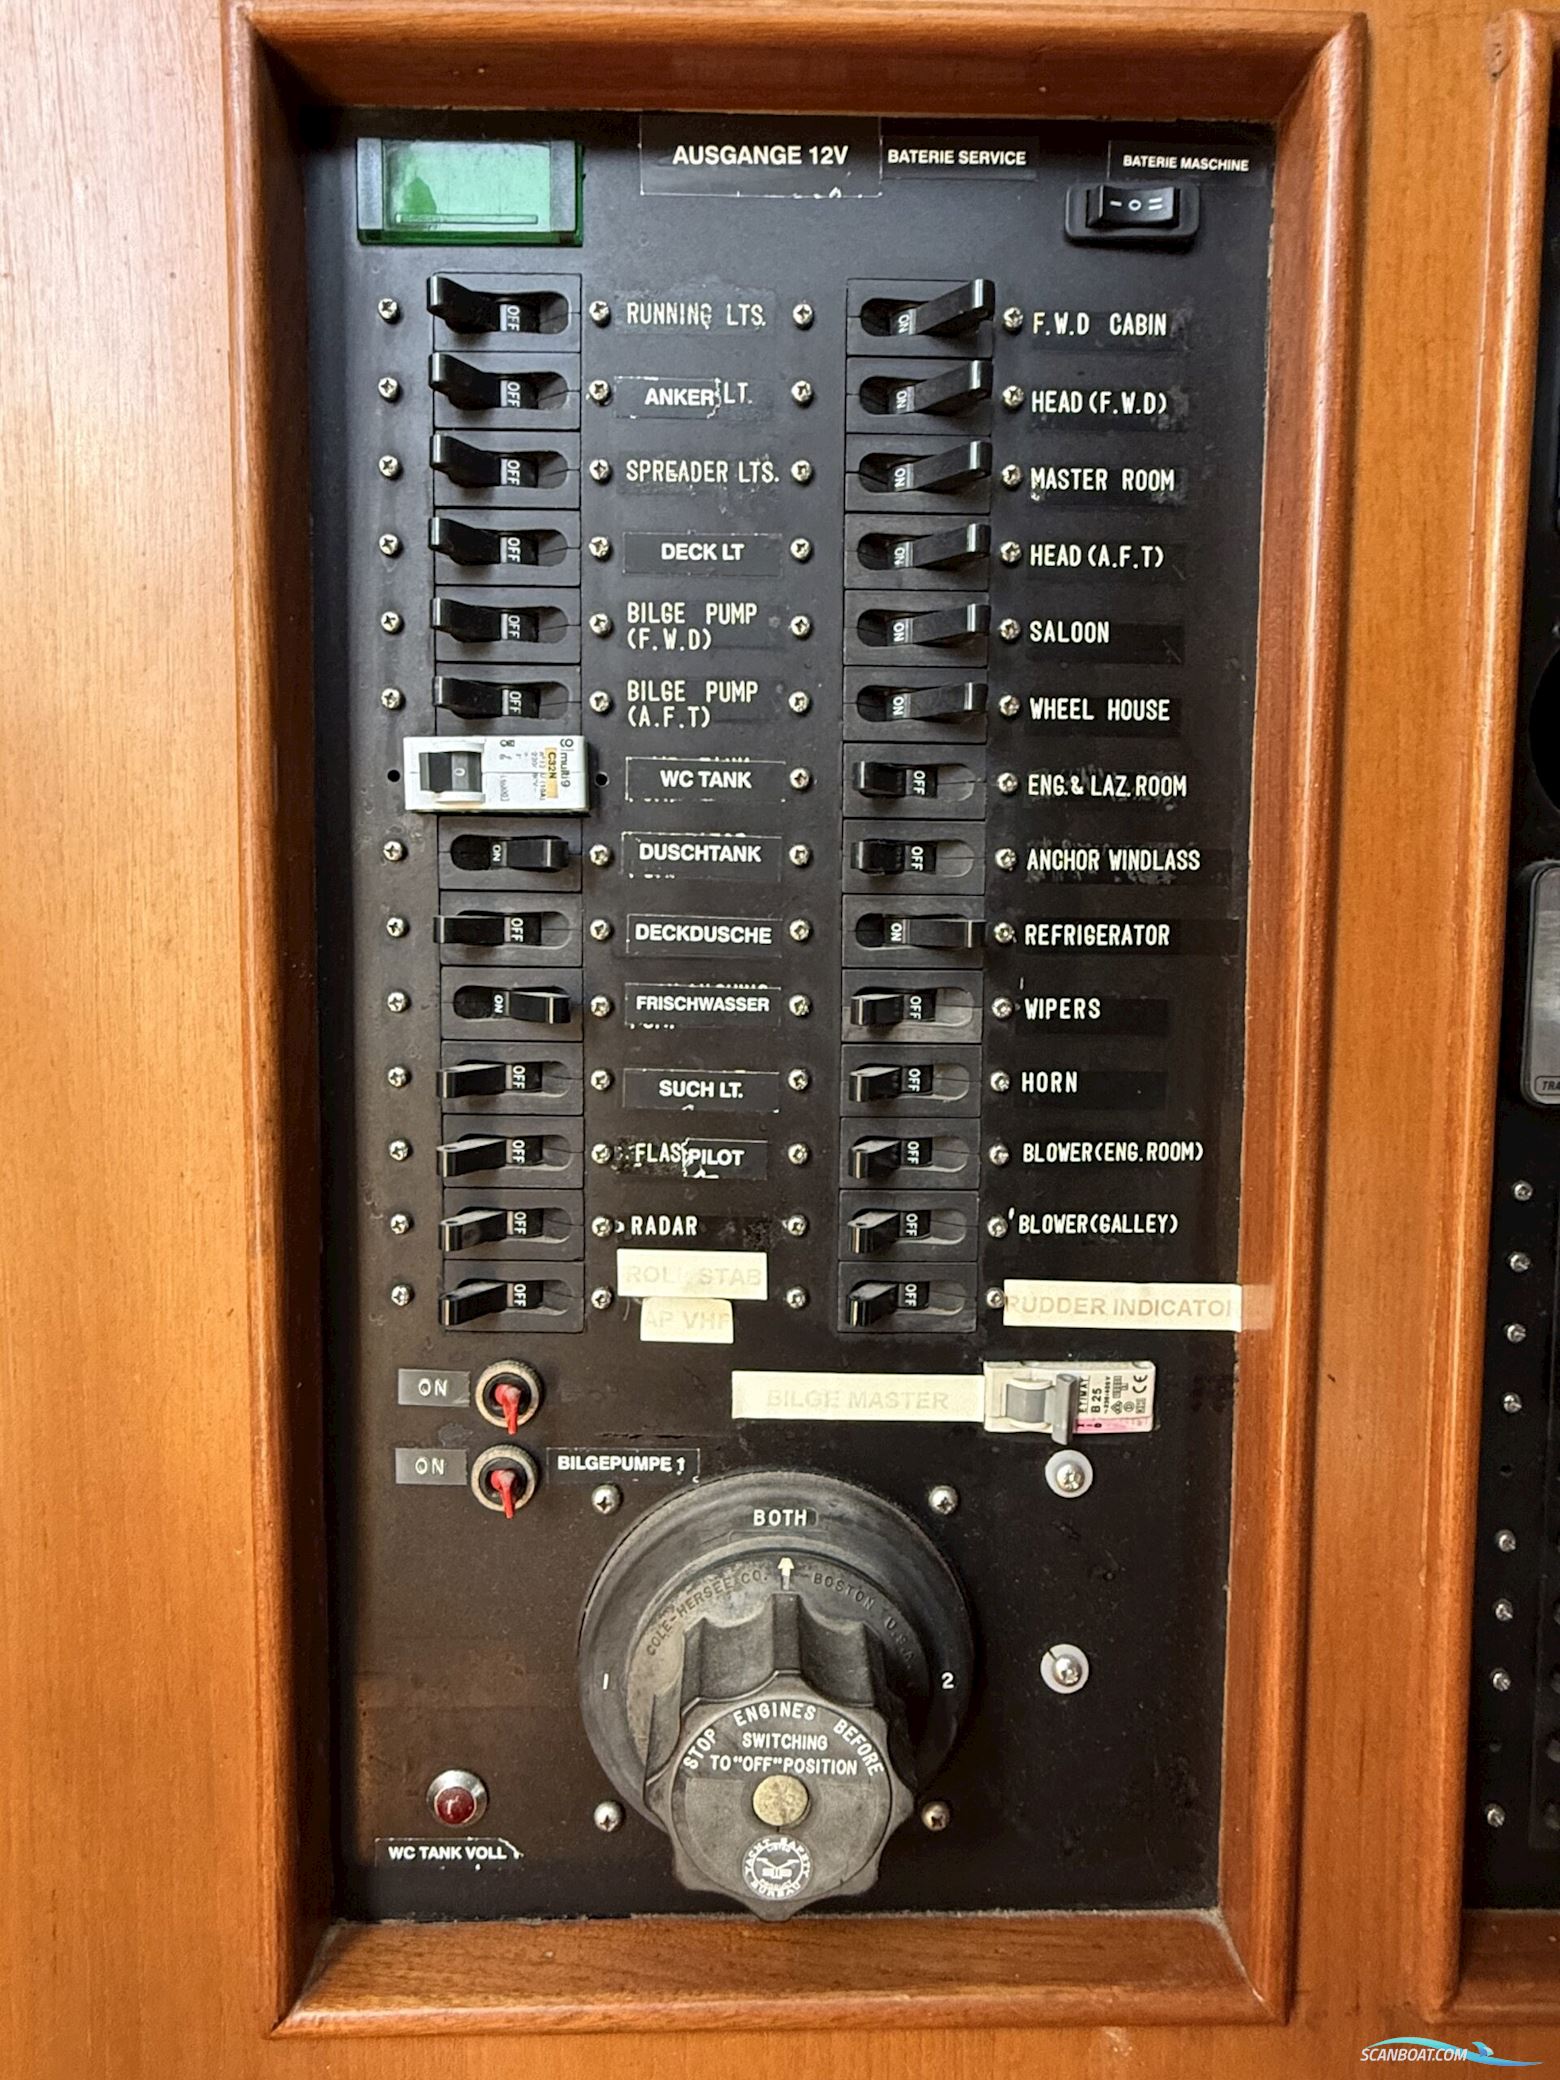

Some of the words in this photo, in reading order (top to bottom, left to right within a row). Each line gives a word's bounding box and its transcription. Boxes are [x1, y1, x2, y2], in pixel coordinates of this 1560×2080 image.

[672, 145, 802, 165] AUSGANGE
[809, 145, 848, 165] 12V
[887, 149, 956, 165] BATERIE
[957, 150, 1027, 166] SERVICE
[1122, 154, 1178, 169] BATERIE
[1180, 157, 1250, 173] MASCHINE
[506, 305, 520, 332] OFF
[626, 302, 712, 329] RUNNING
[726, 304, 767, 327] LTS.
[897, 315, 909, 335] ON
[1032, 313, 1090, 336] F.W.D
[1109, 313, 1167, 336] CABIN
[506, 381, 520, 408] OFF
[644, 387, 715, 406] ANKER
[723, 381, 753, 405] LT.
[896, 390, 908, 409] ON
[507, 459, 520, 486] OFF
[625, 460, 729, 483] SPREADER
[738, 461, 780, 483] LTS.
[893, 468, 906, 488] ON
[1030, 468, 1108, 491] MASTER
[1121, 469, 1175, 491] ROOM
[507, 537, 520, 564] OFF
[661, 542, 719, 561] DECK
[722, 543, 745, 561] LT
[893, 547, 906, 567] ON
[626, 602, 686, 625] BILGE
[705, 603, 758, 625] PUMP
[508, 614, 520, 641] OFF
[893, 622, 905, 642] ON
[1029, 620, 1110, 643] SALOON
[627, 628, 712, 651] (F.W.D)
[626, 680, 686, 703] BILGE
[705, 681, 759, 703] PUMP
[509, 690, 522, 717] OFF
[893, 696, 905, 717] ON
[1029, 698, 1094, 721] WHEEL
[1107, 699, 1170, 722] HOUSE
[627, 705, 711, 729] (A.F.T)
[660, 770, 694, 787] WC
[698, 771, 752, 788] TANK
[913, 769, 926, 796] OFF
[492, 843, 502, 862] ON
[639, 843, 762, 863] DUSCHTANK
[911, 845, 924, 872] OFF
[1026, 848, 1100, 871] ANCHOR
[1109, 849, 1201, 872] WINDLASS
[511, 917, 524, 943] OFF
[634, 923, 772, 945] DECKDUSCHE
[890, 922, 902, 942] ON
[1024, 923, 1170, 947] REFRIGERATOR
[494, 994, 503, 1014] ON
[635, 995, 770, 1012] FRISCHWASSER
[909, 995, 922, 1021] OFF
[1024, 998, 1101, 1020] WIPERS
[513, 1065, 526, 1091] OFF
[908, 1068, 920, 1094] OFF
[1021, 1071, 1078, 1093] HORN
[658, 1081, 714, 1098] SUCH
[718, 1082, 743, 1099] LT.
[513, 1140, 526, 1166] OFF
[688, 1148, 745, 1166] PILOT
[907, 1140, 920, 1165] OFF
[513, 1211, 526, 1237] OFF
[630, 1216, 698, 1237] RADAR
[905, 1212, 918, 1238] OFF
[698, 1267, 762, 1287] STAB
[513, 1282, 526, 1308] OFF
[905, 1283, 918, 1308] OFF
[1007, 1295, 1107, 1316] RUDDER
[417, 1378, 448, 1397] ON
[766, 1388, 840, 1409] BILGE
[847, 1390, 951, 1411] MASTER
[414, 1458, 446, 1476] ON
[557, 1455, 672, 1472] BILGEPUMPE
[753, 1509, 808, 1527] BOTH
[645, 1577, 734, 1657] COLE-HERSEE
[739, 1569, 769, 1584] CO.
[941, 1672, 955, 1690] 2
[682, 1728, 717, 1771] STOP
[733, 1701, 817, 1727] ENGINES
[833, 1719, 885, 1777] BEFORE
[742, 1732, 828, 1751] SWITCHING
[388, 1845, 416, 1860] WC
[418, 1845, 463, 1860] TANK
[464, 1846, 507, 1860] VOLL
